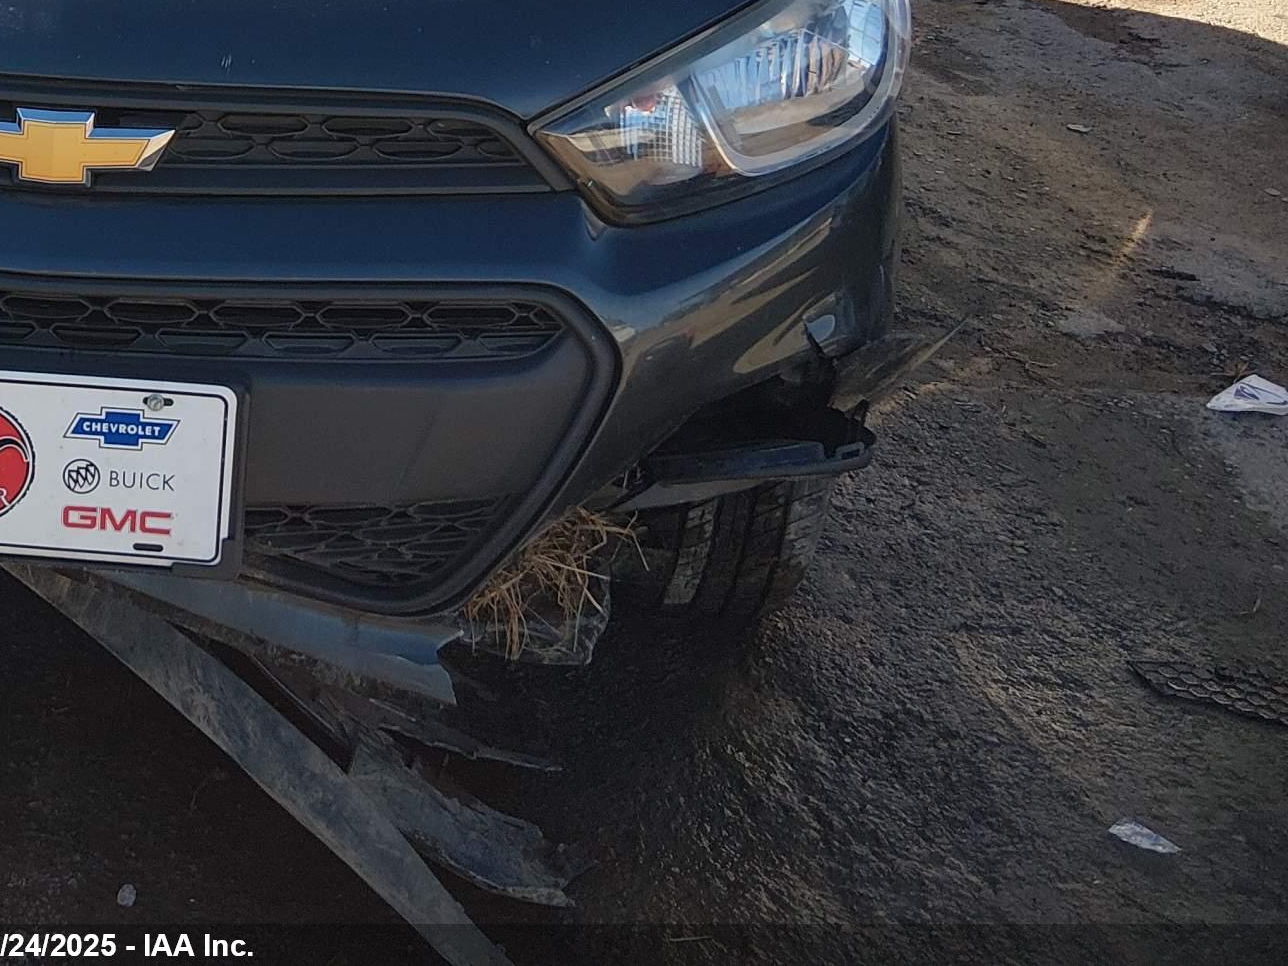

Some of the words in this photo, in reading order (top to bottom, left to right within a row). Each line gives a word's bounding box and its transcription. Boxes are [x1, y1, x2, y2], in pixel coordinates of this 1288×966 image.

[82, 420, 162, 437] CHEVROLET
[108, 470, 176, 492] BUICK
[61, 505, 174, 535] GMC
